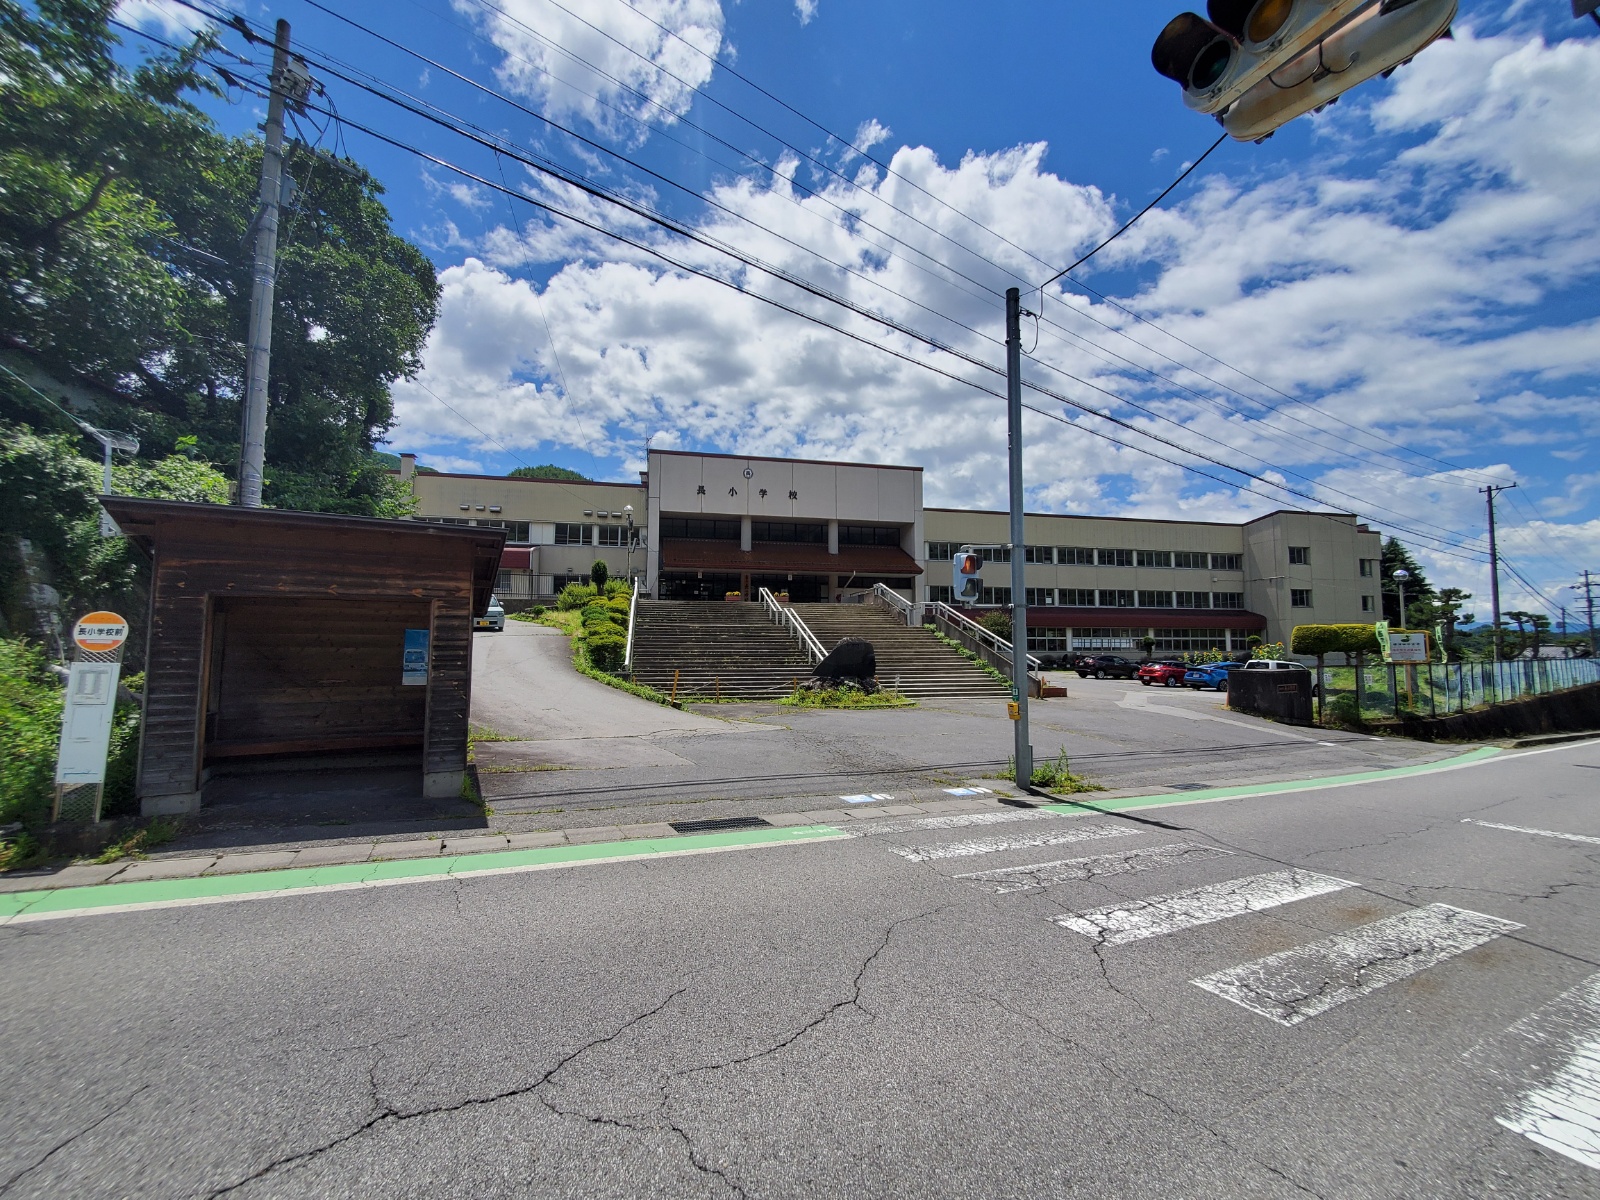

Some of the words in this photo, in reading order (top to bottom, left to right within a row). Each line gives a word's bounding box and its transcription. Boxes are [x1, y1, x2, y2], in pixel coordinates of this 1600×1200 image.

[696, 485, 798, 500] 長小学校
[78, 627, 124, 636] 長小学校前
